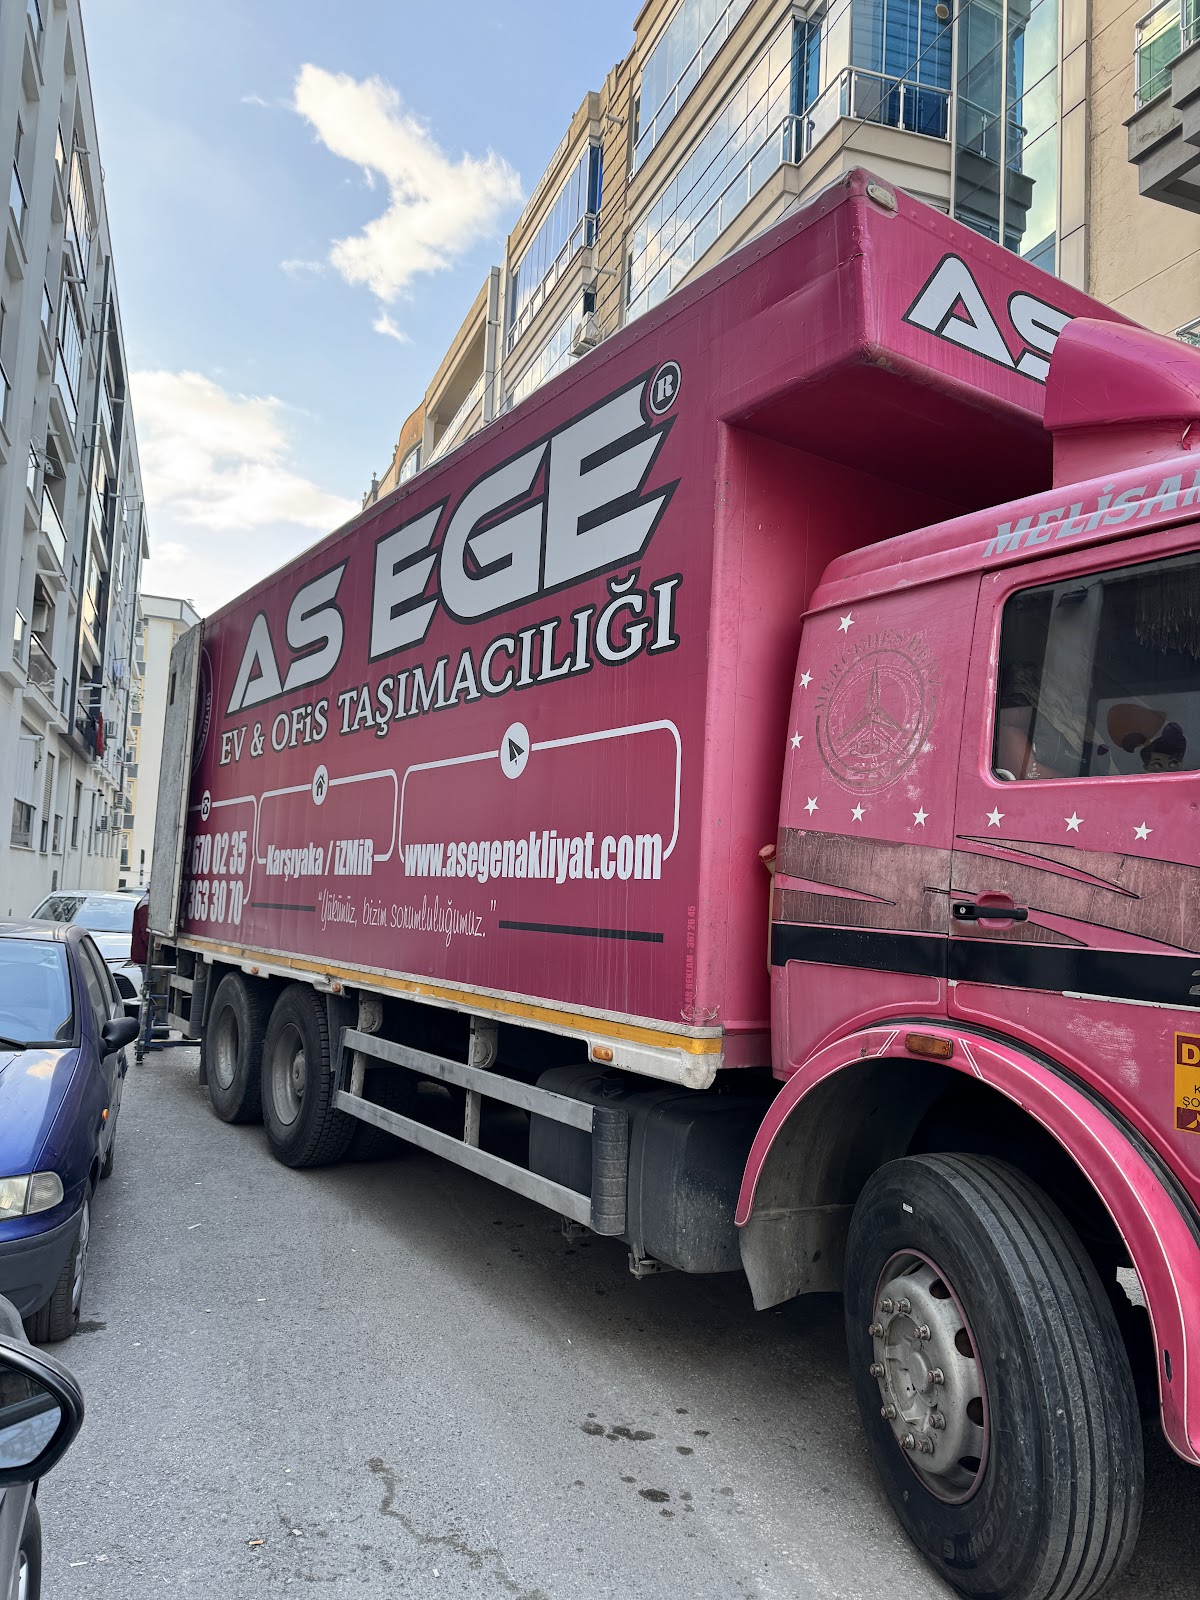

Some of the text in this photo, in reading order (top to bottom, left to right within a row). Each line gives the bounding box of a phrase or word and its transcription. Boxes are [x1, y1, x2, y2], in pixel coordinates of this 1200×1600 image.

[225, 562, 347, 714] AS
[369, 378, 668, 661] EGE
[218, 725, 248, 766] EV
[250, 722, 266, 757] &
[337, 574, 679, 737] TAŞIMACILIĞI
[192, 833, 212, 875] 670
[212, 832, 230, 875] 02
[230, 830, 248, 875] 35
[265, 842, 325, 882] Karşıyaka
[324, 840, 334, 876] /
[404, 829, 663, 885] www.asegenakliyat.com
[188, 879, 210, 921] 363
[210, 879, 228, 924] 30
[227, 880, 244, 926] 70
[362, 896, 388, 928] bizim
